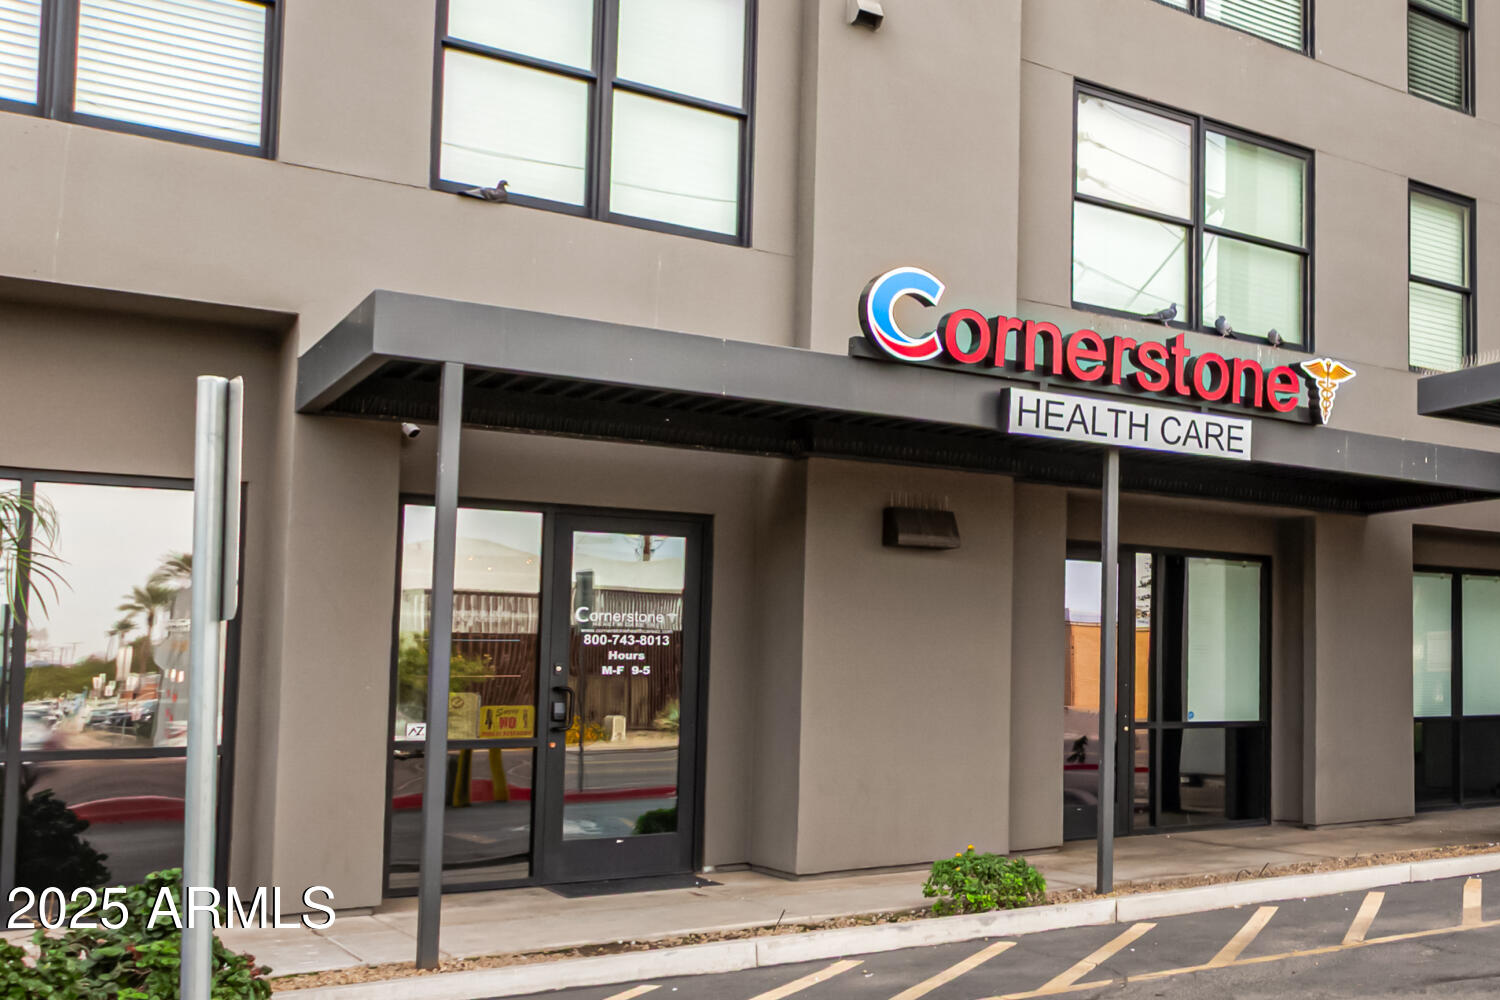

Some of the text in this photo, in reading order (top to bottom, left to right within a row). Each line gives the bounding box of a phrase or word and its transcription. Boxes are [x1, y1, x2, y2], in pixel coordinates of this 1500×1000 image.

[862, 265, 1300, 412] Cornerstone
[1017, 397, 1245, 454] HEALTH CARE
[575, 606, 665, 623] Cornerstone
[583, 634, 670, 646] 800-743-8013
[607, 650, 646, 661] Hours
[601, 665, 651, 675] M-F 9-5
